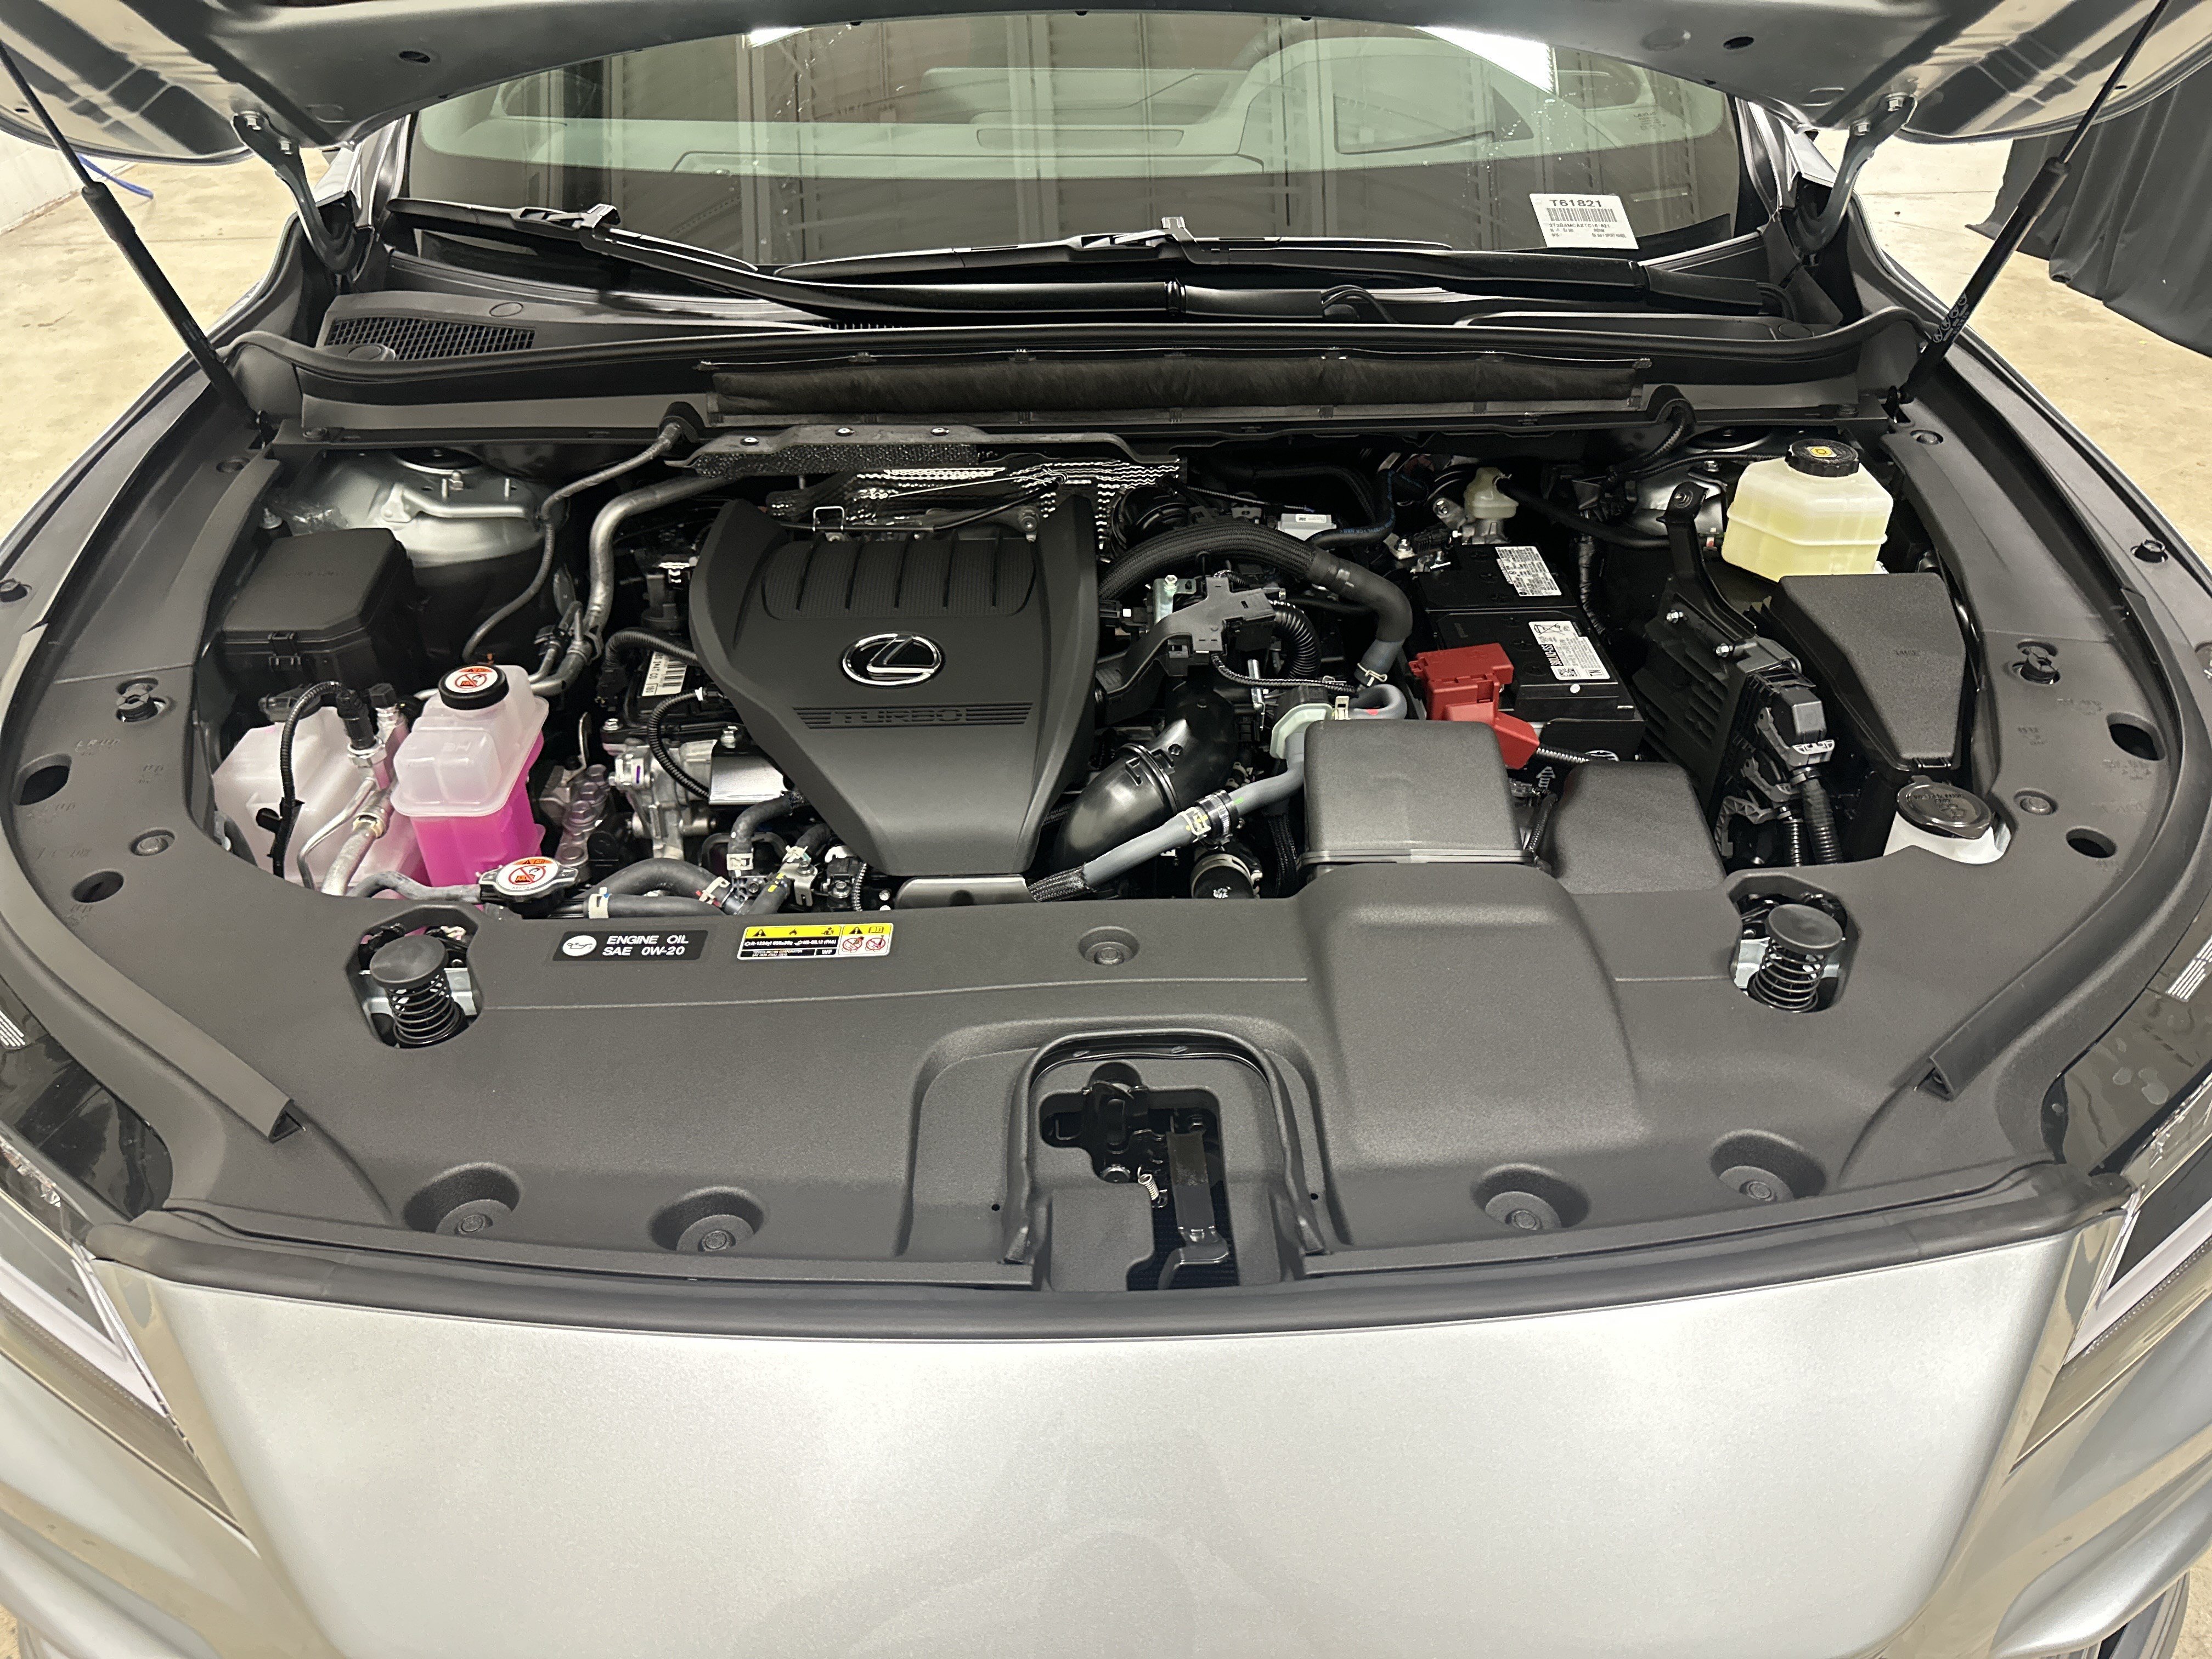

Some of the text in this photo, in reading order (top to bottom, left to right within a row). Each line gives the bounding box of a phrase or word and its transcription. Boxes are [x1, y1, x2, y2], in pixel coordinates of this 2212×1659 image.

[1550, 199, 1602, 207] T61821
[834, 708, 963, 724] TURBO
[606, 935, 689, 944] ENGINE OIL
[602, 946, 686, 956] SAE 0W-20
